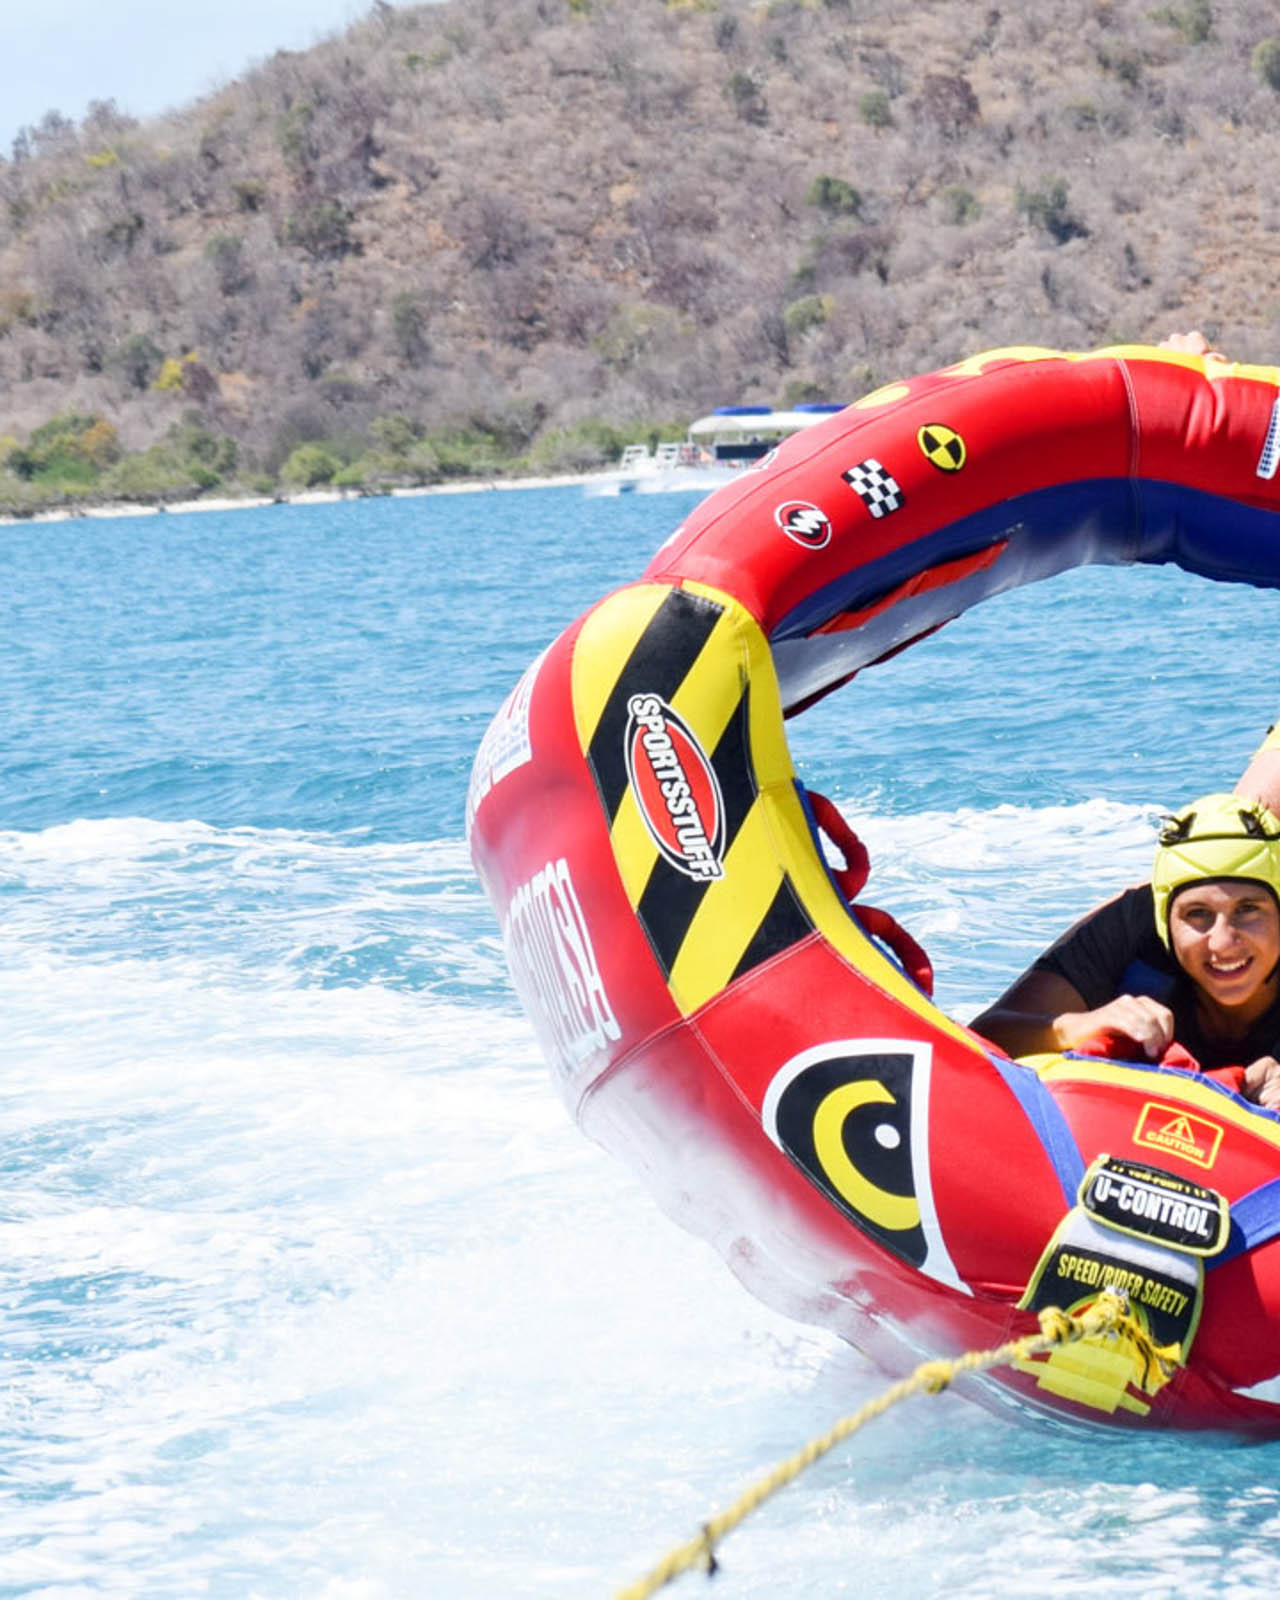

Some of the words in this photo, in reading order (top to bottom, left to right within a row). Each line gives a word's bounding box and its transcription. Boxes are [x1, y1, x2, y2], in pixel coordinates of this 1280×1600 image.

[629, 695, 724, 882] SPORTSSTUFF
[1146, 1130, 1205, 1159] CAUTION
[1094, 1176, 1209, 1235] U-CONTROL
[1057, 1253, 1144, 1298] SPEED/RIDER
[1140, 1279, 1189, 1317] SAFETY
